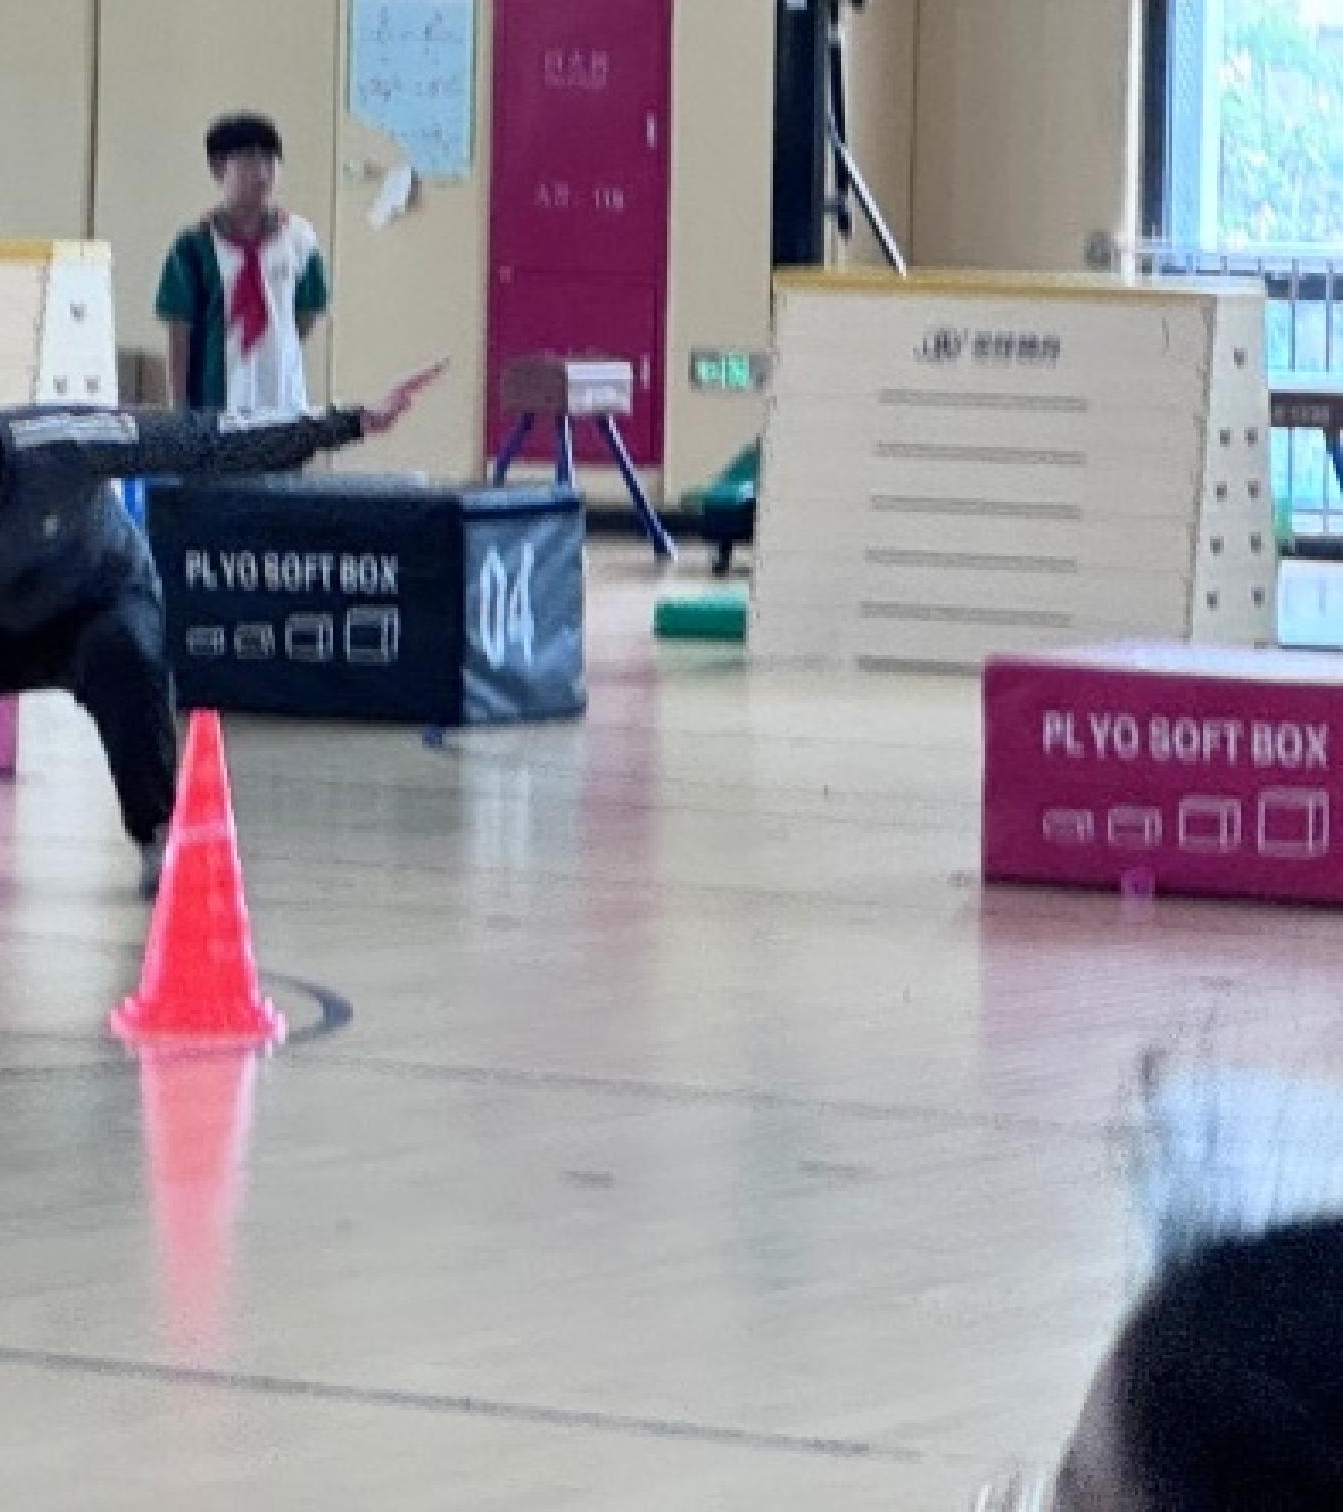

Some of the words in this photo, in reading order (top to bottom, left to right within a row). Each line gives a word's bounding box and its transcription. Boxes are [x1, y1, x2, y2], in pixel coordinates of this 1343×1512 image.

[265, 552, 334, 593] SOFT
[340, 553, 399, 595] BOX
[479, 543, 534, 670] 04
[1149, 713, 1243, 764] SOFT
[1251, 719, 1329, 770] BOX
